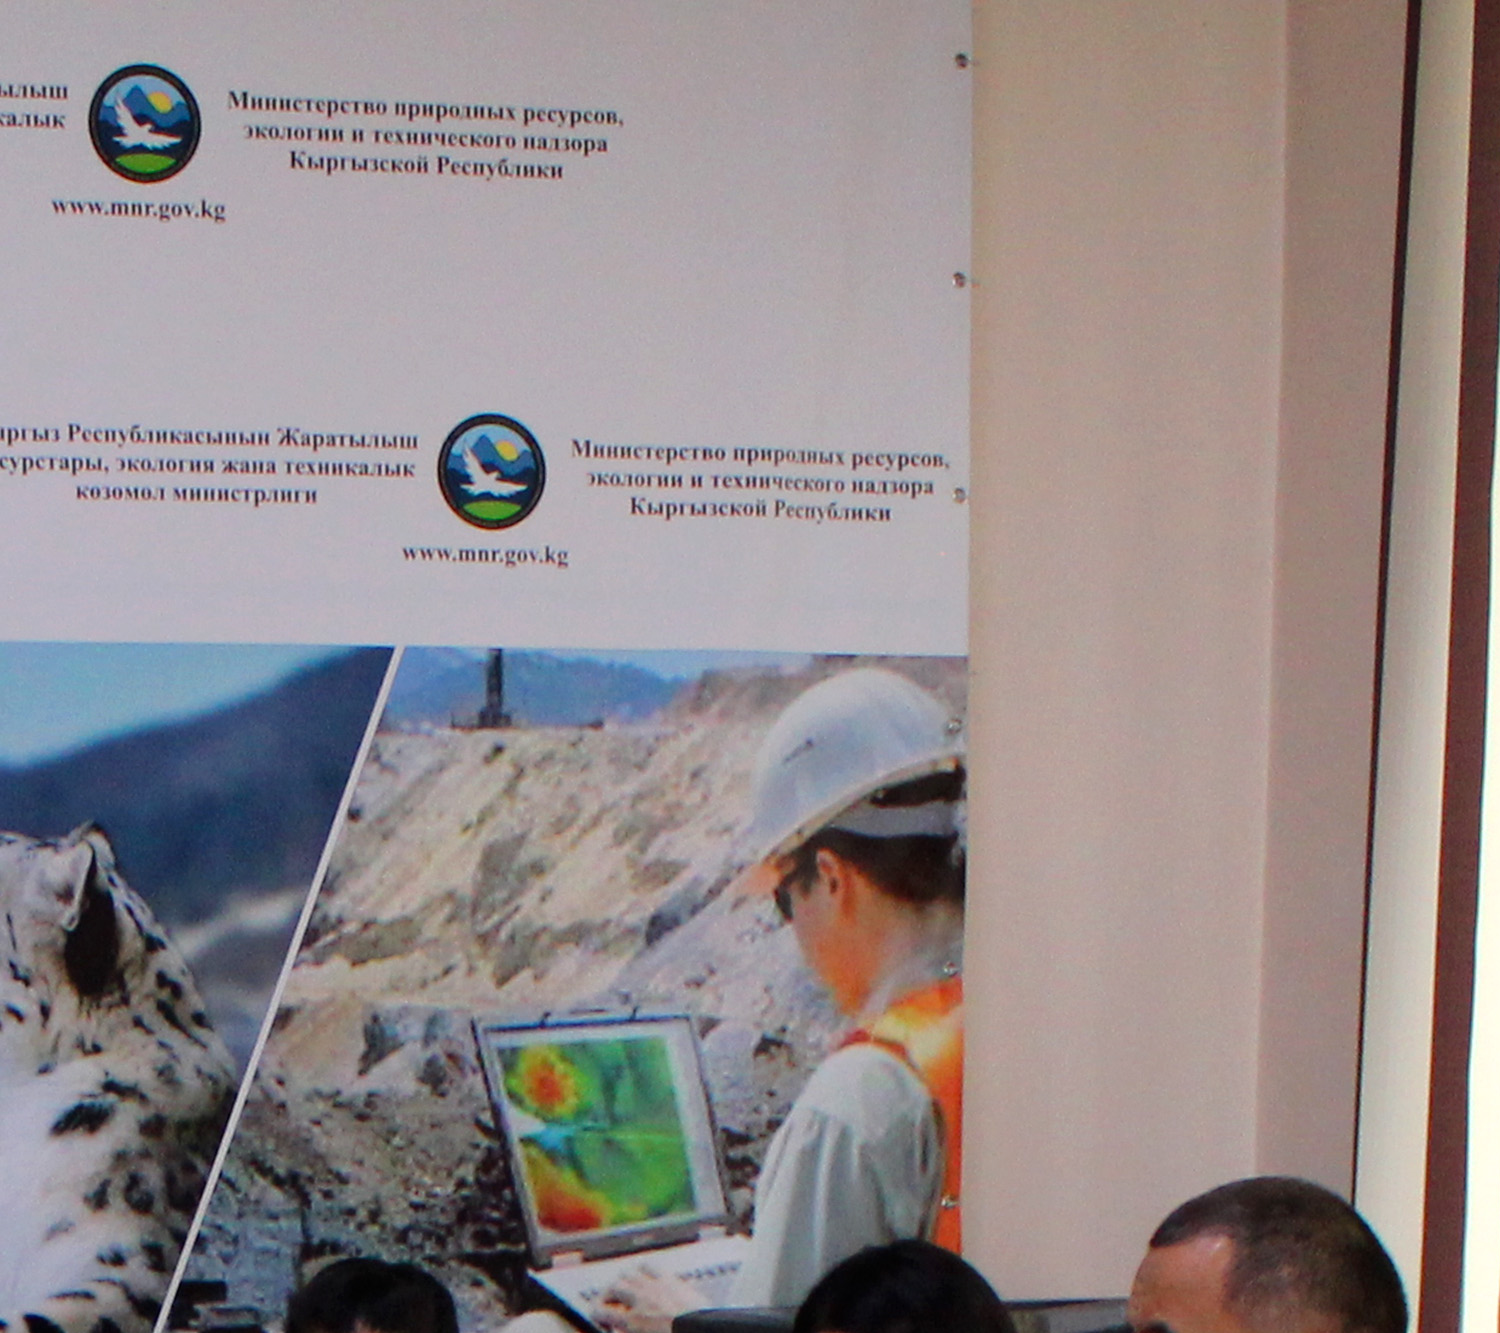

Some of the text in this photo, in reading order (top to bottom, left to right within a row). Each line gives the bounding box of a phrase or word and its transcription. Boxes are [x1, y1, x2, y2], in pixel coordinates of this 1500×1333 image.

[228, 90, 624, 130] Министерство природных ресурсов,
[244, 124, 607, 157] экологии и технического надзора
[289, 149, 564, 182] Кыргызской Республики
[51, 198, 227, 224] www.mnr.gov.kg
[68, 422, 270, 449] Республикасынын
[276, 426, 418, 453] Жаратылыш
[116, 457, 215, 474] экология
[222, 459, 277, 475] жана
[285, 460, 416, 478] техникалык
[572, 439, 950, 473] Министерство природных ресурсов,
[173, 486, 318, 509] министрлиги
[587, 472, 933, 499] экологии и технического надзора
[630, 495, 892, 525] Кыргызской Республики
[401, 544, 569, 569] www.mnr.gov.kg
